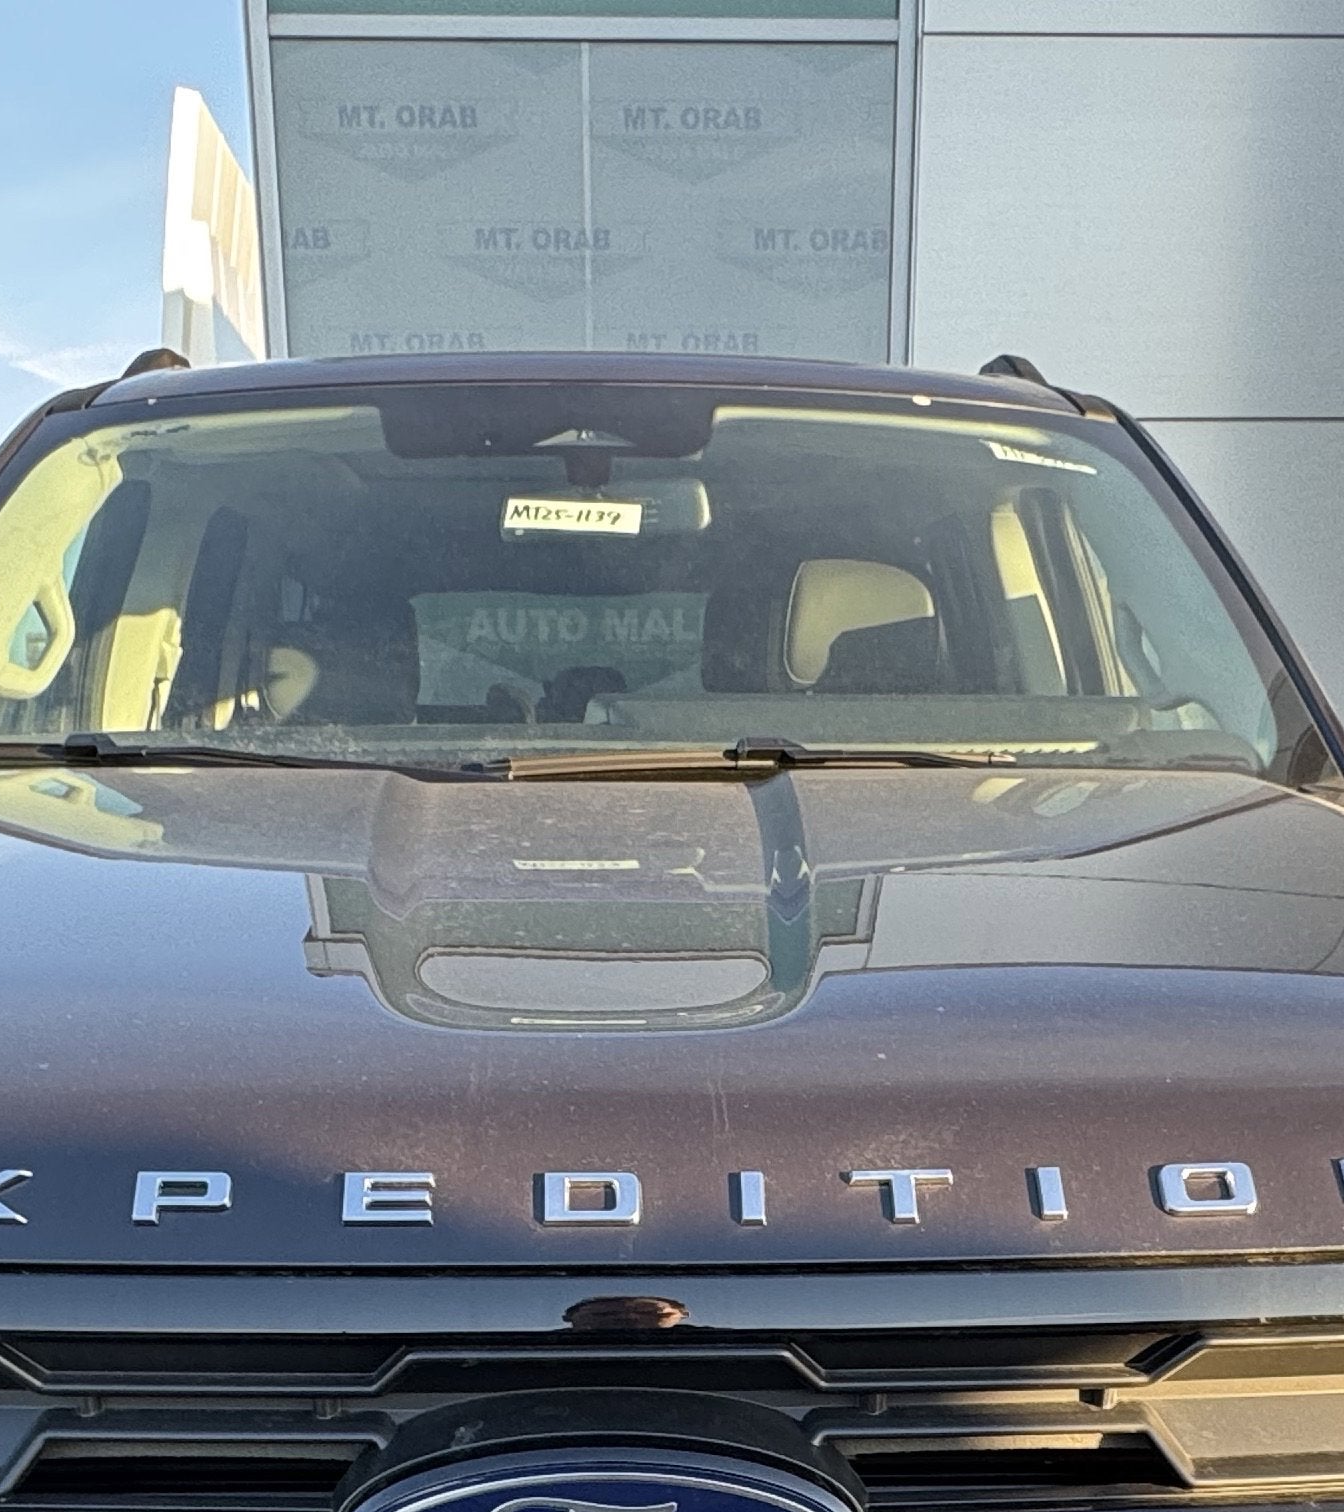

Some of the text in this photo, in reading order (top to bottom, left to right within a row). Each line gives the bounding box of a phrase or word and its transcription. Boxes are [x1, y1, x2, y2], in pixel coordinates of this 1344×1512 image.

[395, 104, 478, 129] ORAB
[680, 106, 762, 131] ORAB
[283, 226, 331, 249] AB
[532, 228, 610, 250] ORAB
[809, 228, 889, 251] ORAB
[465, 607, 705, 643] AUTO MAL
